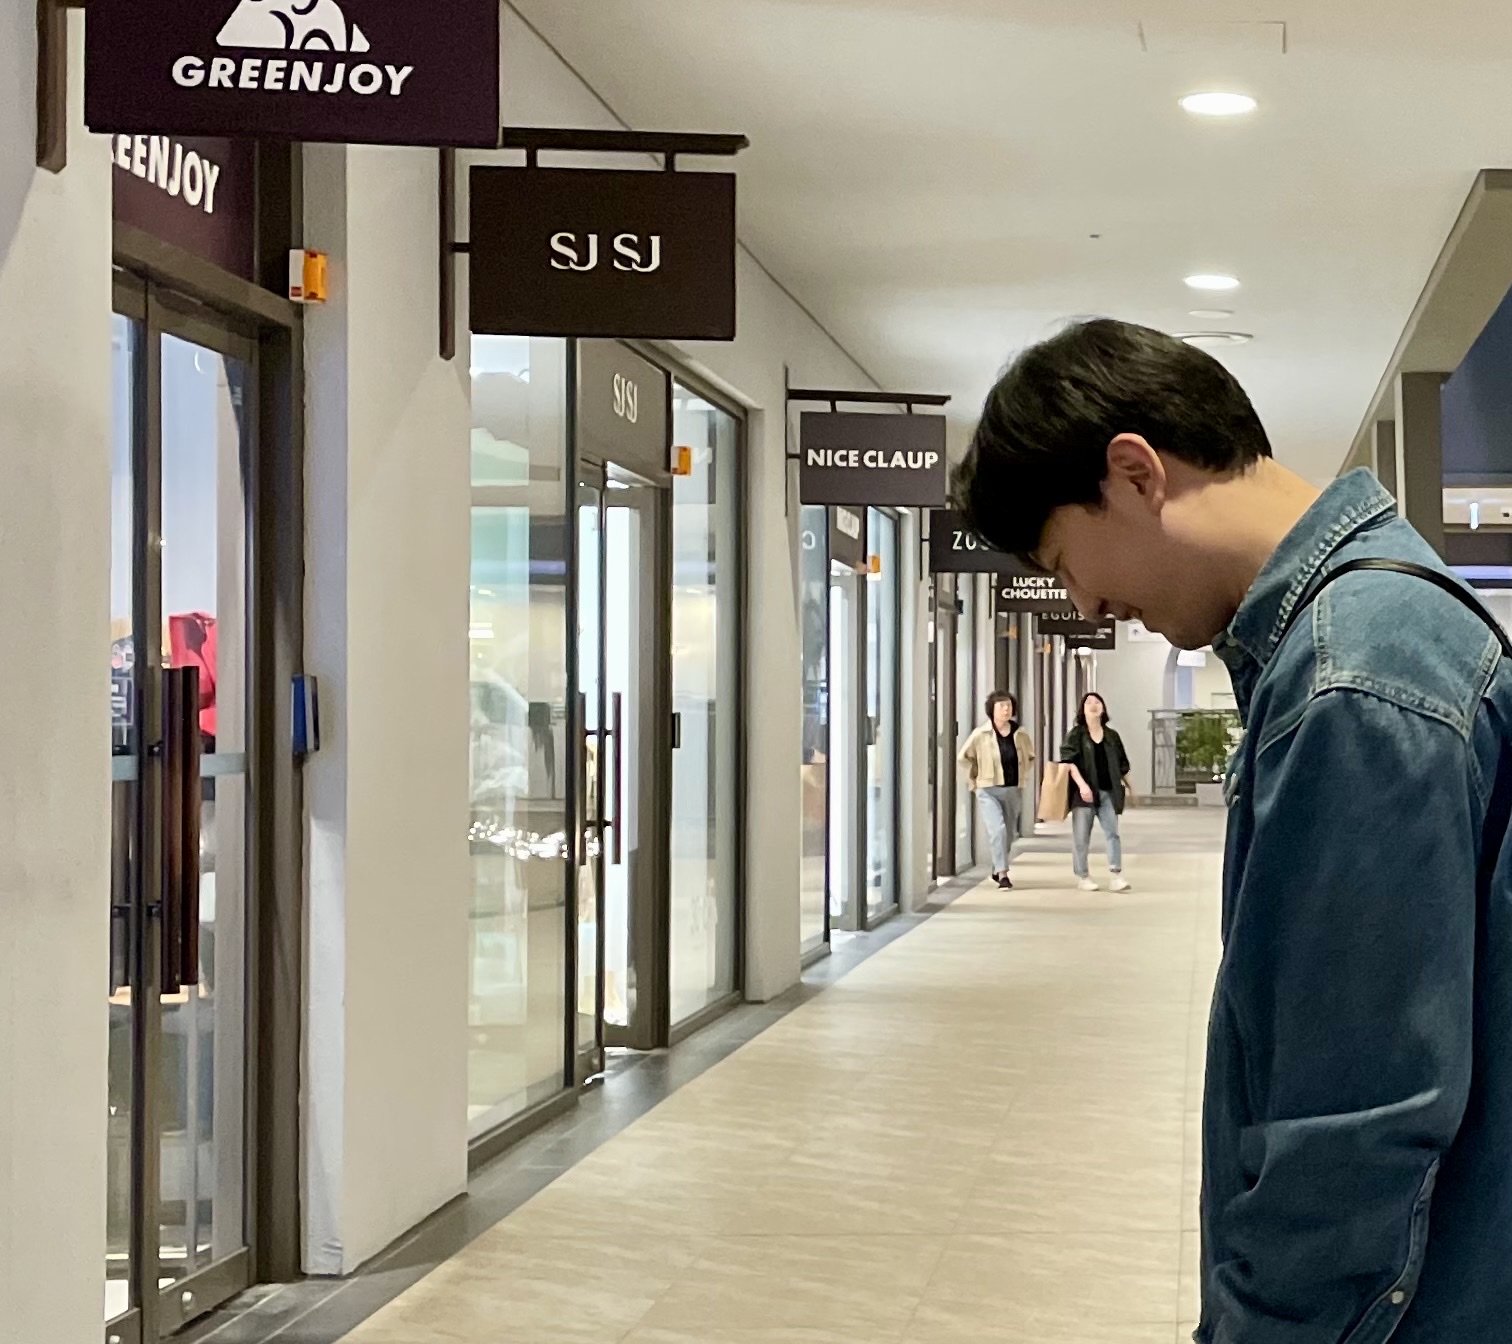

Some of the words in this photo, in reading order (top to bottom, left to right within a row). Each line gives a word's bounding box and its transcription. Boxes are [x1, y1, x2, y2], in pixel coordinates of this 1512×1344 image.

[172, 56, 413, 95] GREENJOY
[111, 133, 219, 213] EENJOY
[807, 449, 859, 467] NICE
[863, 450, 938, 469] CLAUP
[1012, 577, 1055, 587] LUCKY
[1001, 588, 1067, 600] CHOUETTE
